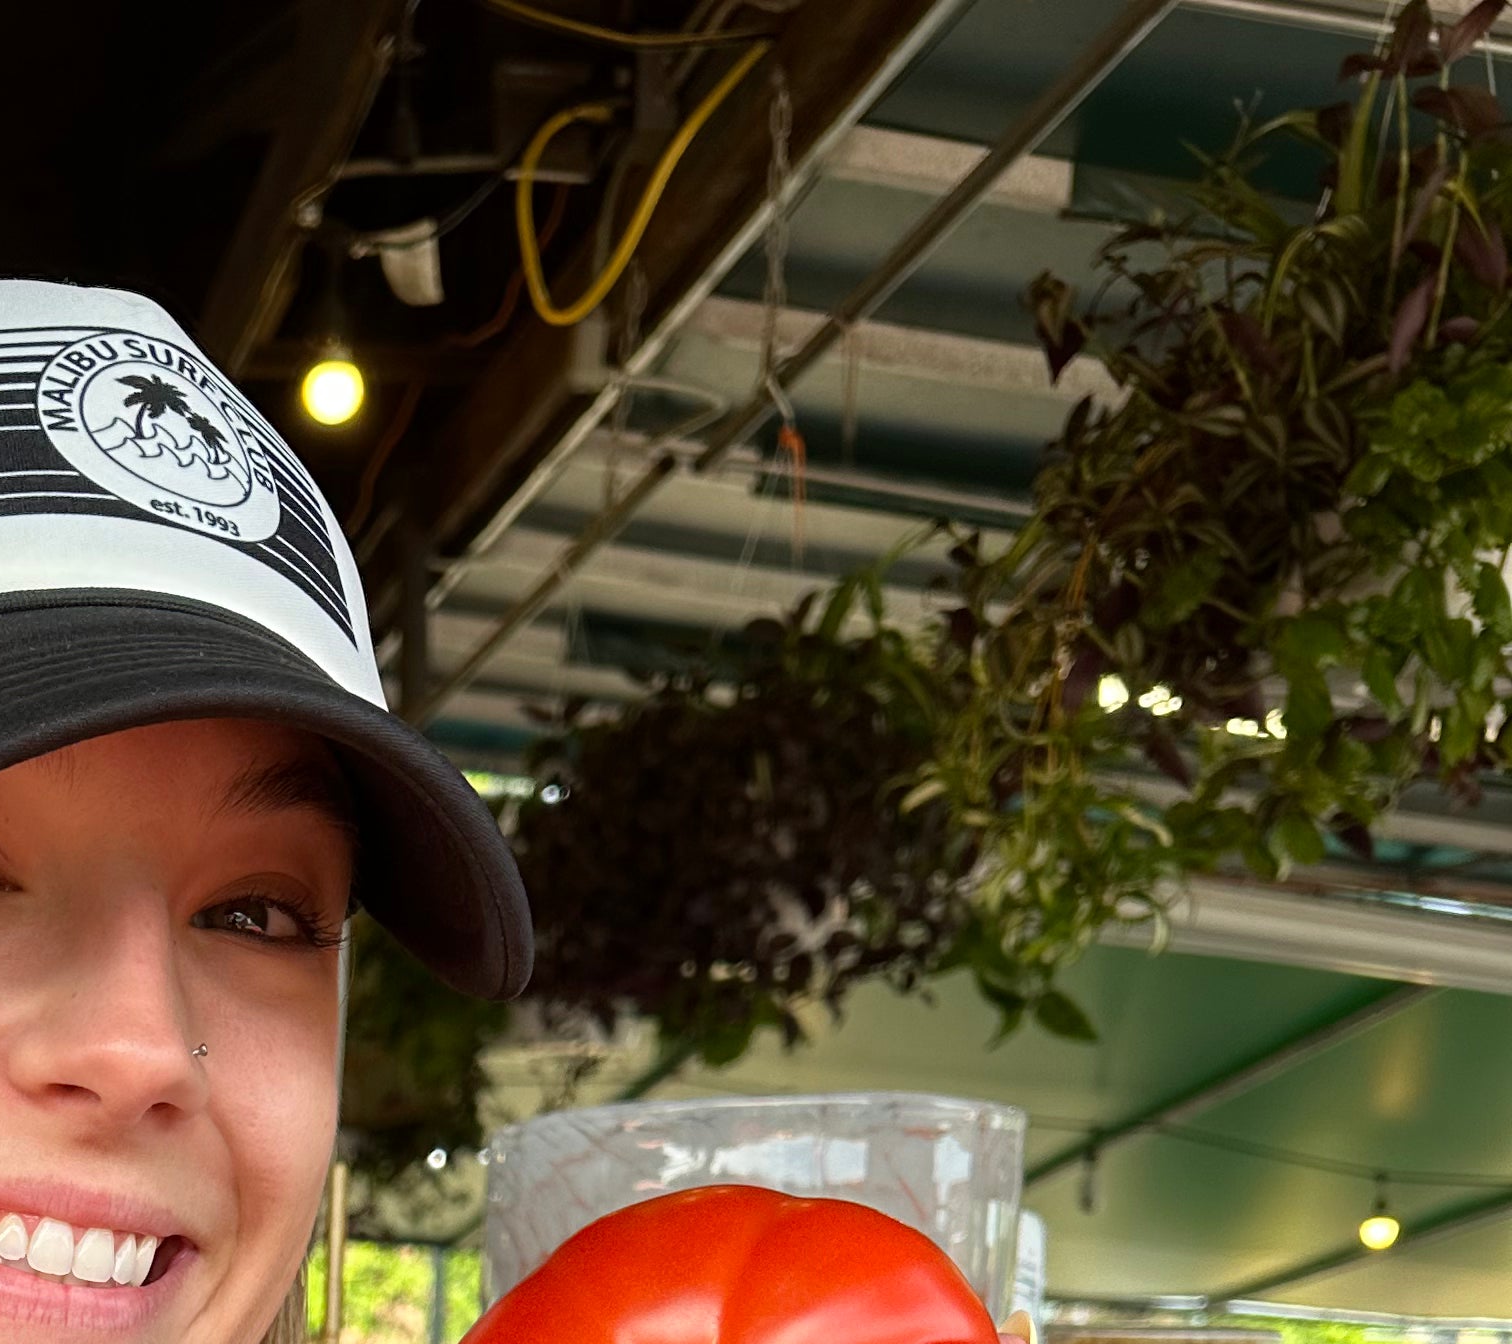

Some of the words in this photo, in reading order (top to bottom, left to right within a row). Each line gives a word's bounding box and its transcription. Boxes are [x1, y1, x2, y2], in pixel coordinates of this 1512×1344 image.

[41, 339, 119, 433] MALIBU
[123, 338, 219, 396] SURF
[219, 399, 275, 494] CLUB
[149, 498, 191, 519] est.
[192, 506, 241, 537] 1993
